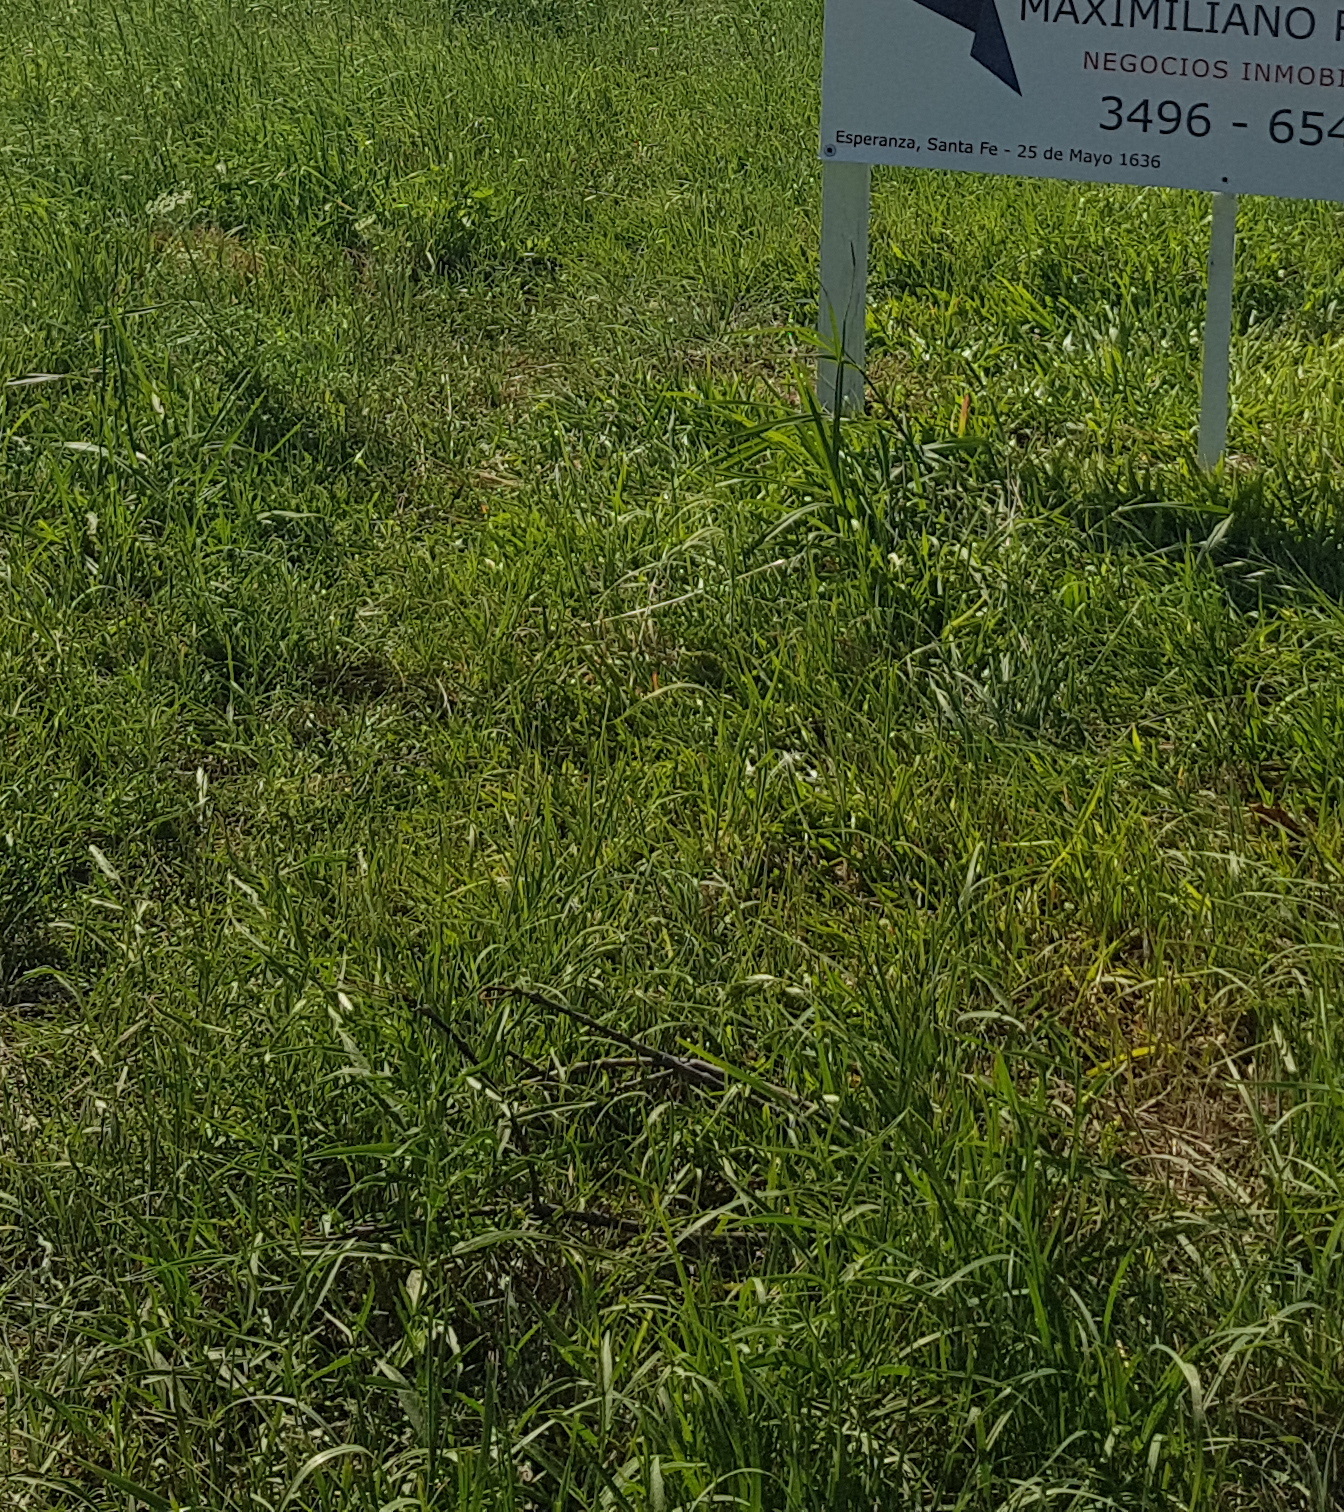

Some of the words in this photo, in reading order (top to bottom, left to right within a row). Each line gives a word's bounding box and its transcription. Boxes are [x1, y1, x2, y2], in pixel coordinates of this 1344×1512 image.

[1083, 50, 1228, 80] NEGOCIOS
[1099, 95, 1211, 138] 3496
[835, 129, 921, 153] Esperanza,
[926, 137, 974, 154] Santa
[979, 141, 999, 157] Fe
[1017, 144, 1038, 160] 25
[1043, 146, 1064, 162] de
[1069, 148, 1113, 168] Mayo
[1119, 152, 1161, 169] 1636
